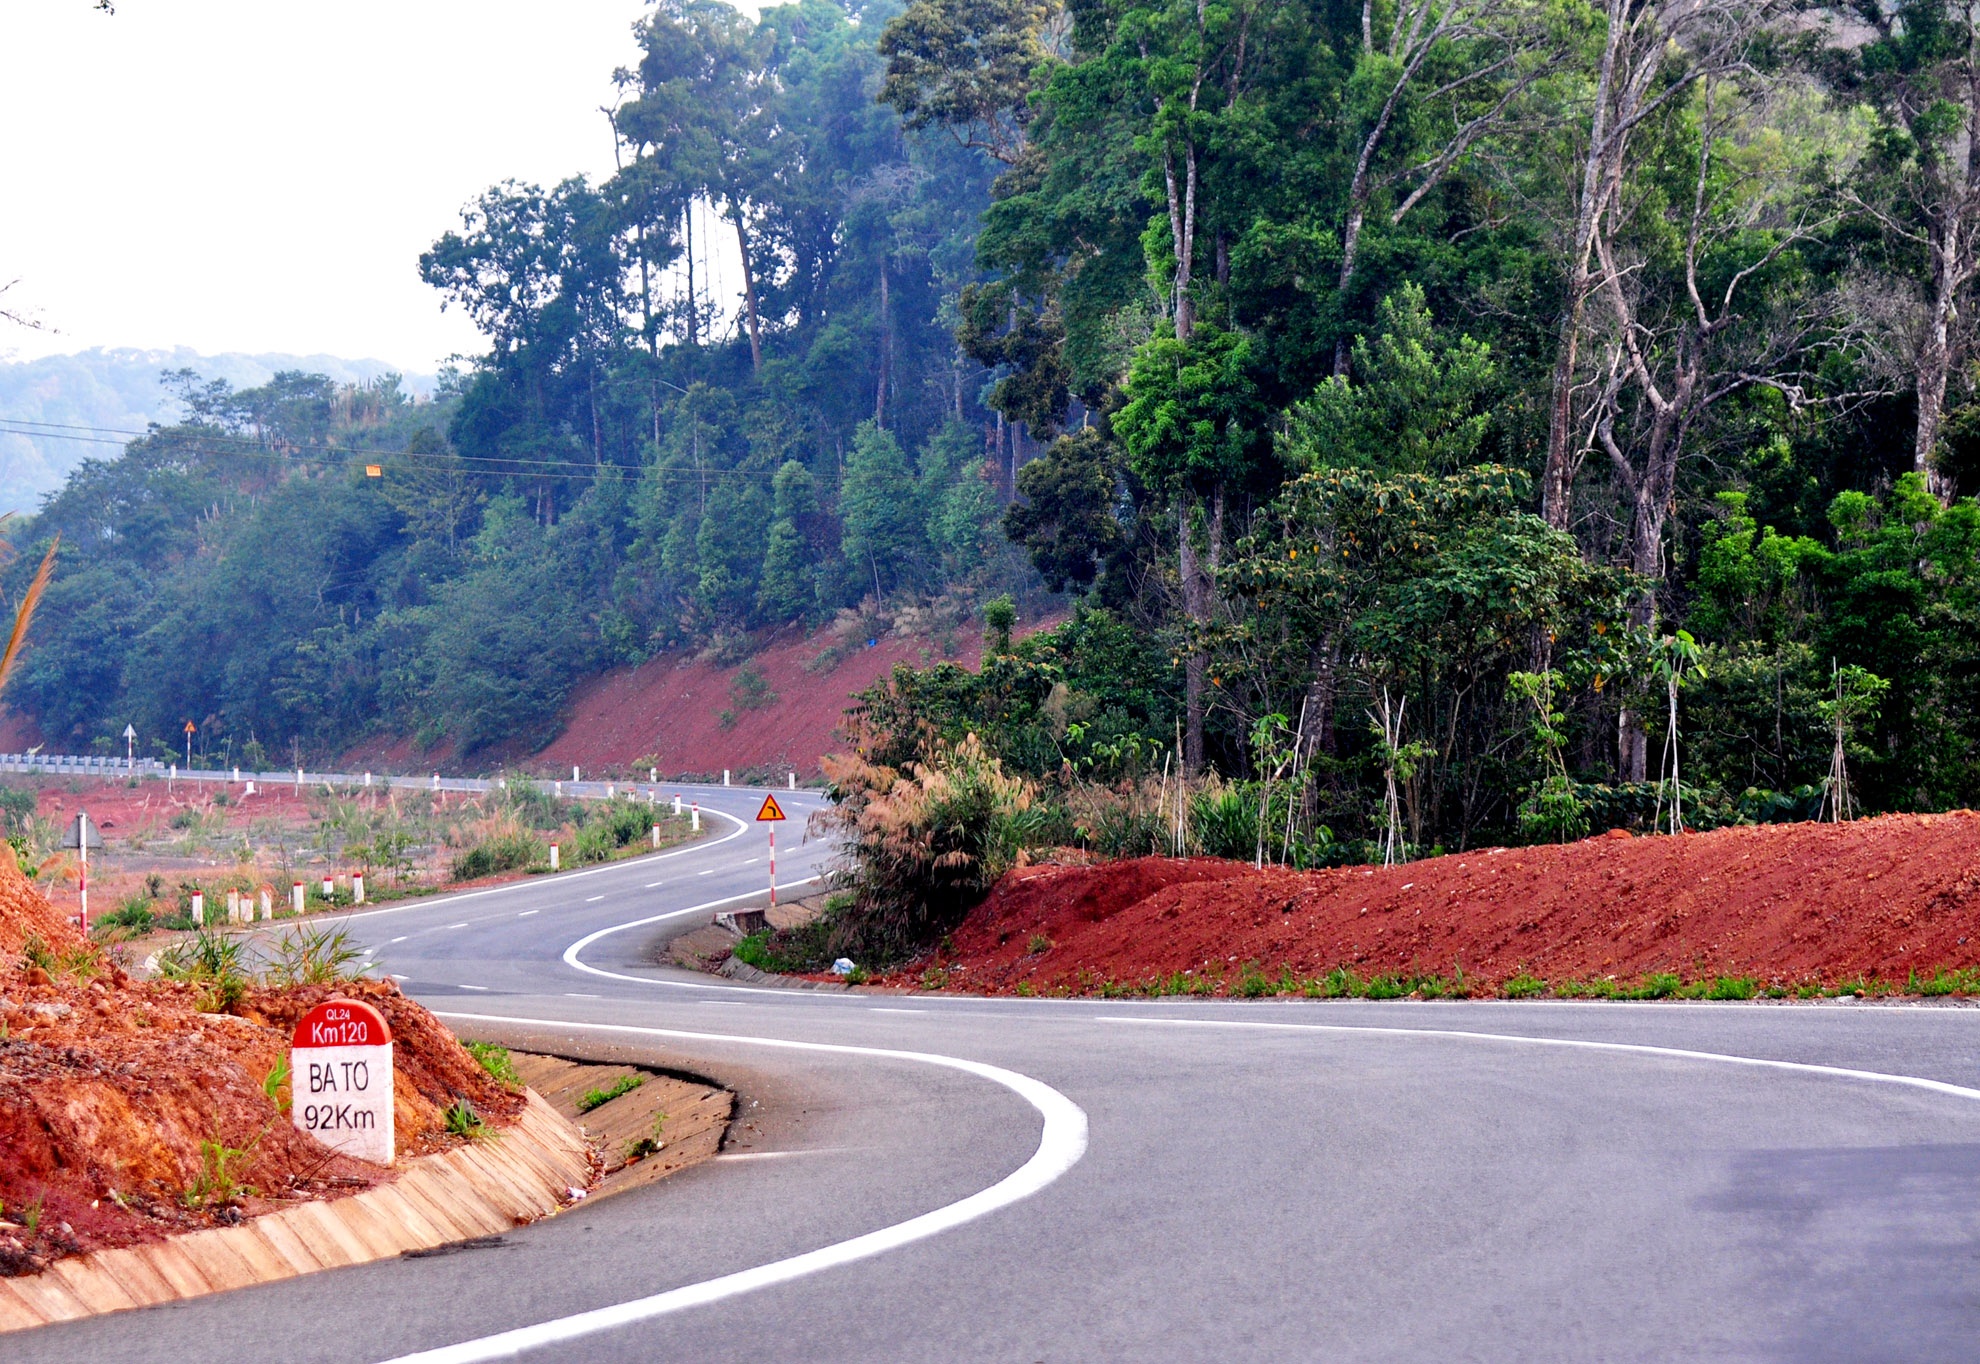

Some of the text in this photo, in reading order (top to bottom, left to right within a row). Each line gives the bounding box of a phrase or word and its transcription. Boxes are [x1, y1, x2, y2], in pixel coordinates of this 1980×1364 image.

[326, 1008, 350, 1020] QL24
[312, 1021, 368, 1043] Km120
[310, 1063, 337, 1093] BA
[304, 1104, 375, 1130] 92Km
